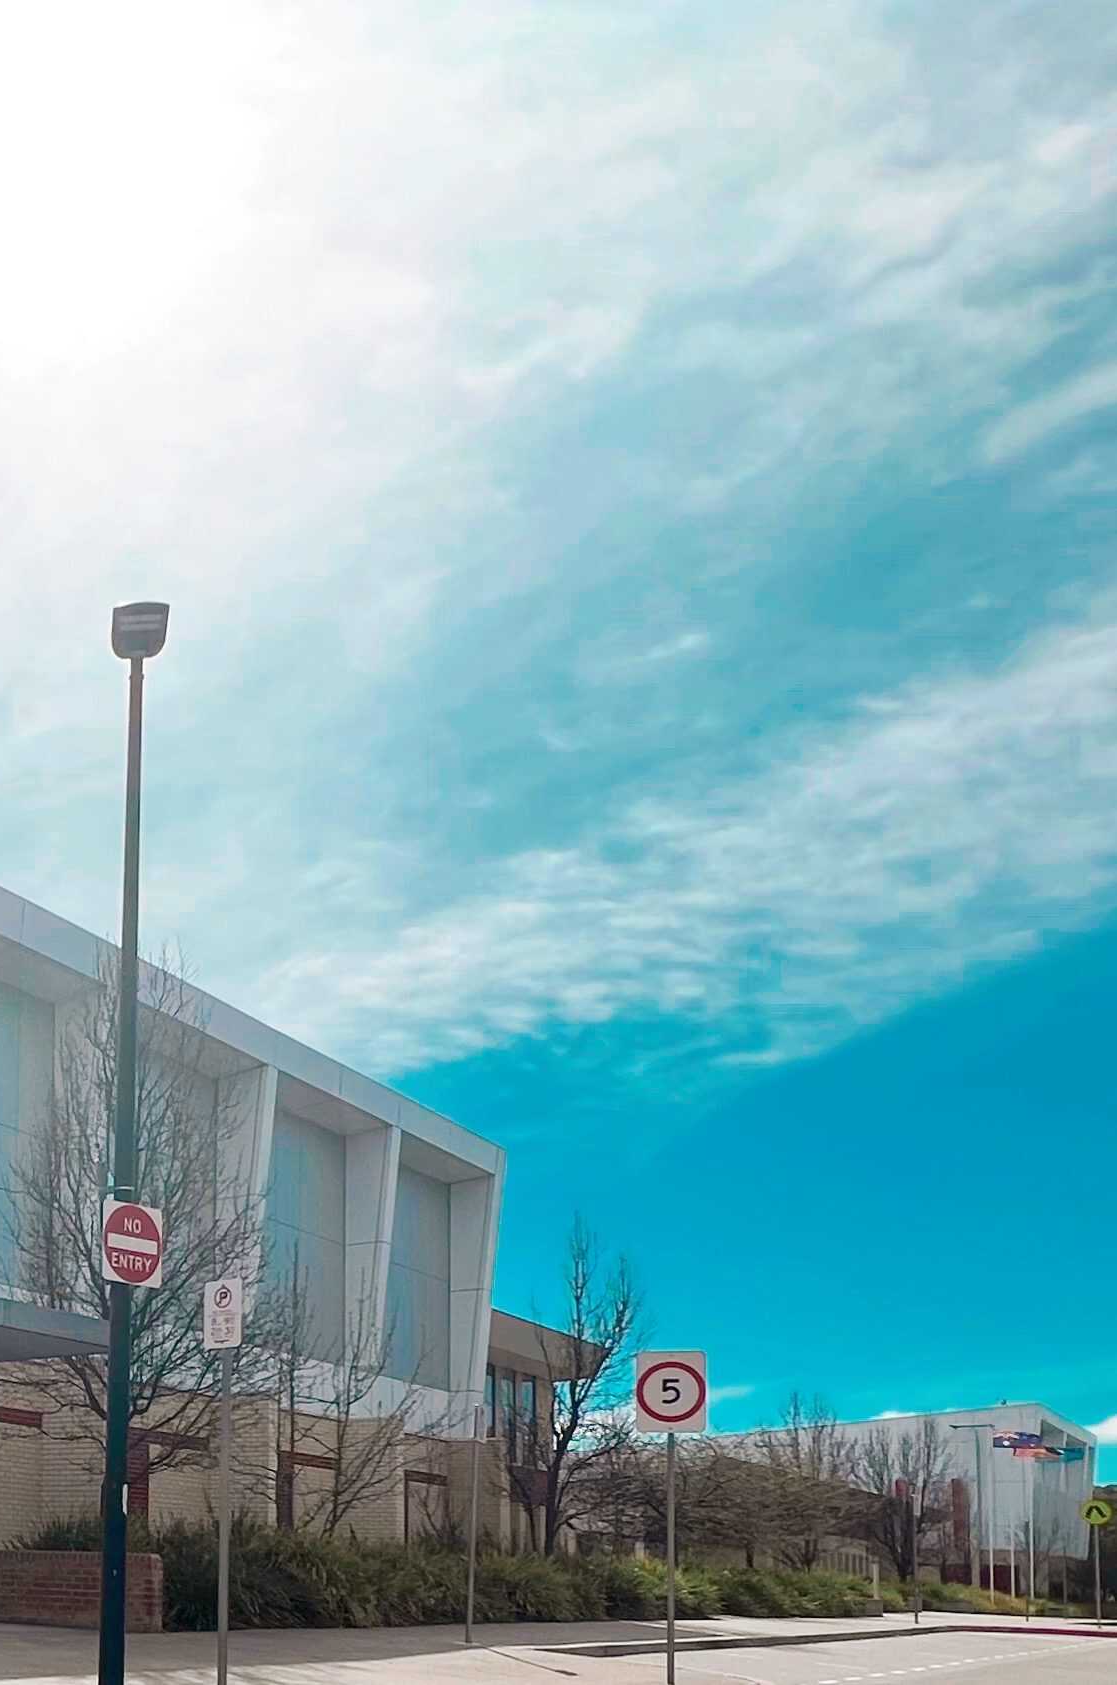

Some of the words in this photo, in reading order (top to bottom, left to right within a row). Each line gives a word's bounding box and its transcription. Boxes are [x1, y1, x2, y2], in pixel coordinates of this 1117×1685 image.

[124, 1216, 141, 1233] NO
[111, 1252, 153, 1272] ENTRY
[219, 1291, 228, 1304] P
[662, 1379, 680, 1404] 5
